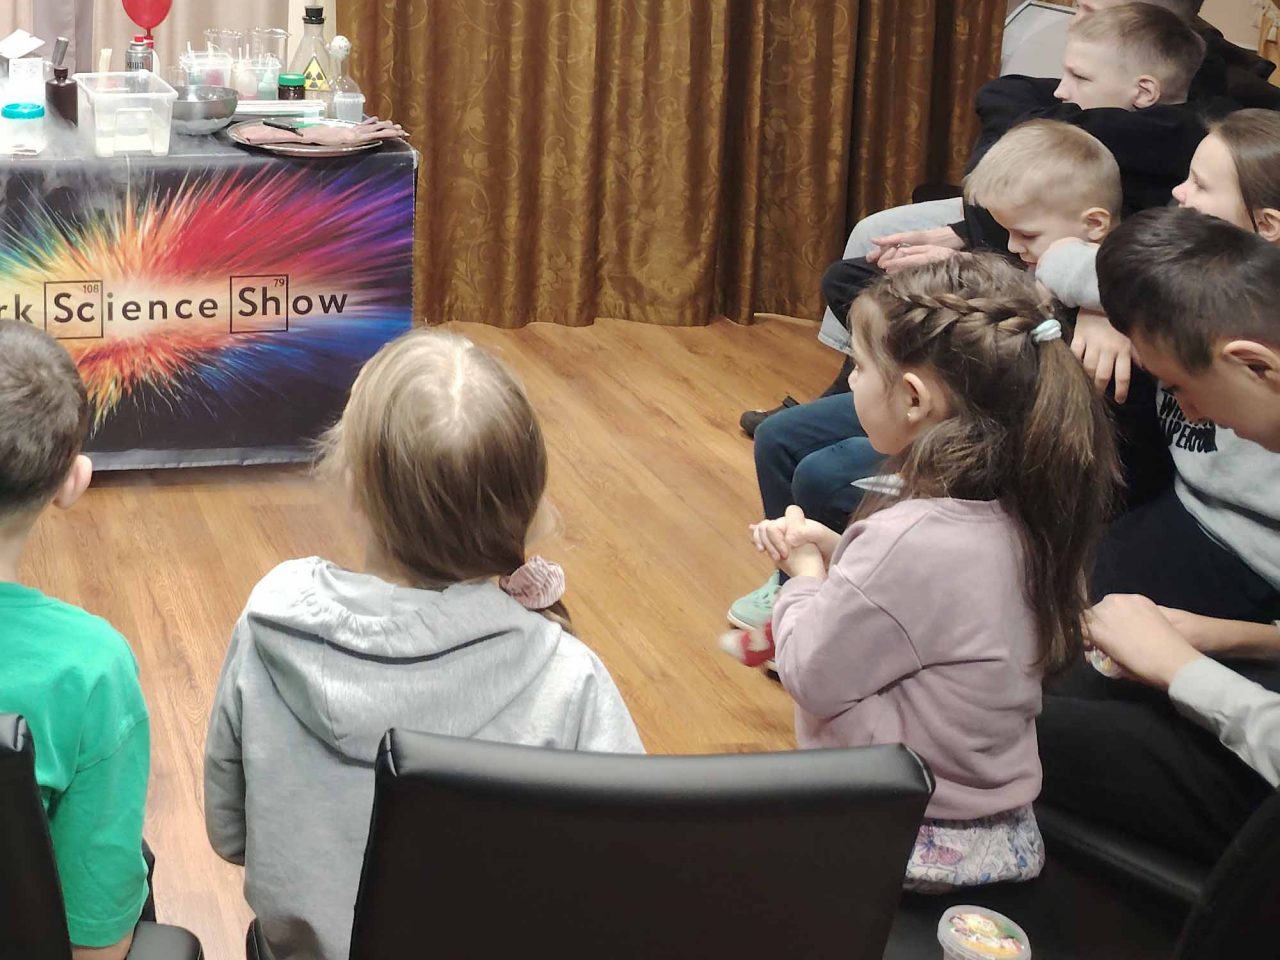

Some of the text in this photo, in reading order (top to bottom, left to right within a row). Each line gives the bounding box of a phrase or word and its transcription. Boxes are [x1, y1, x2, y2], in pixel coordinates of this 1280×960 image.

[82, 283, 100, 294] 108
[273, 278, 286, 288] 79
[53, 292, 219, 324] Science
[237, 286, 348, 317] Show
